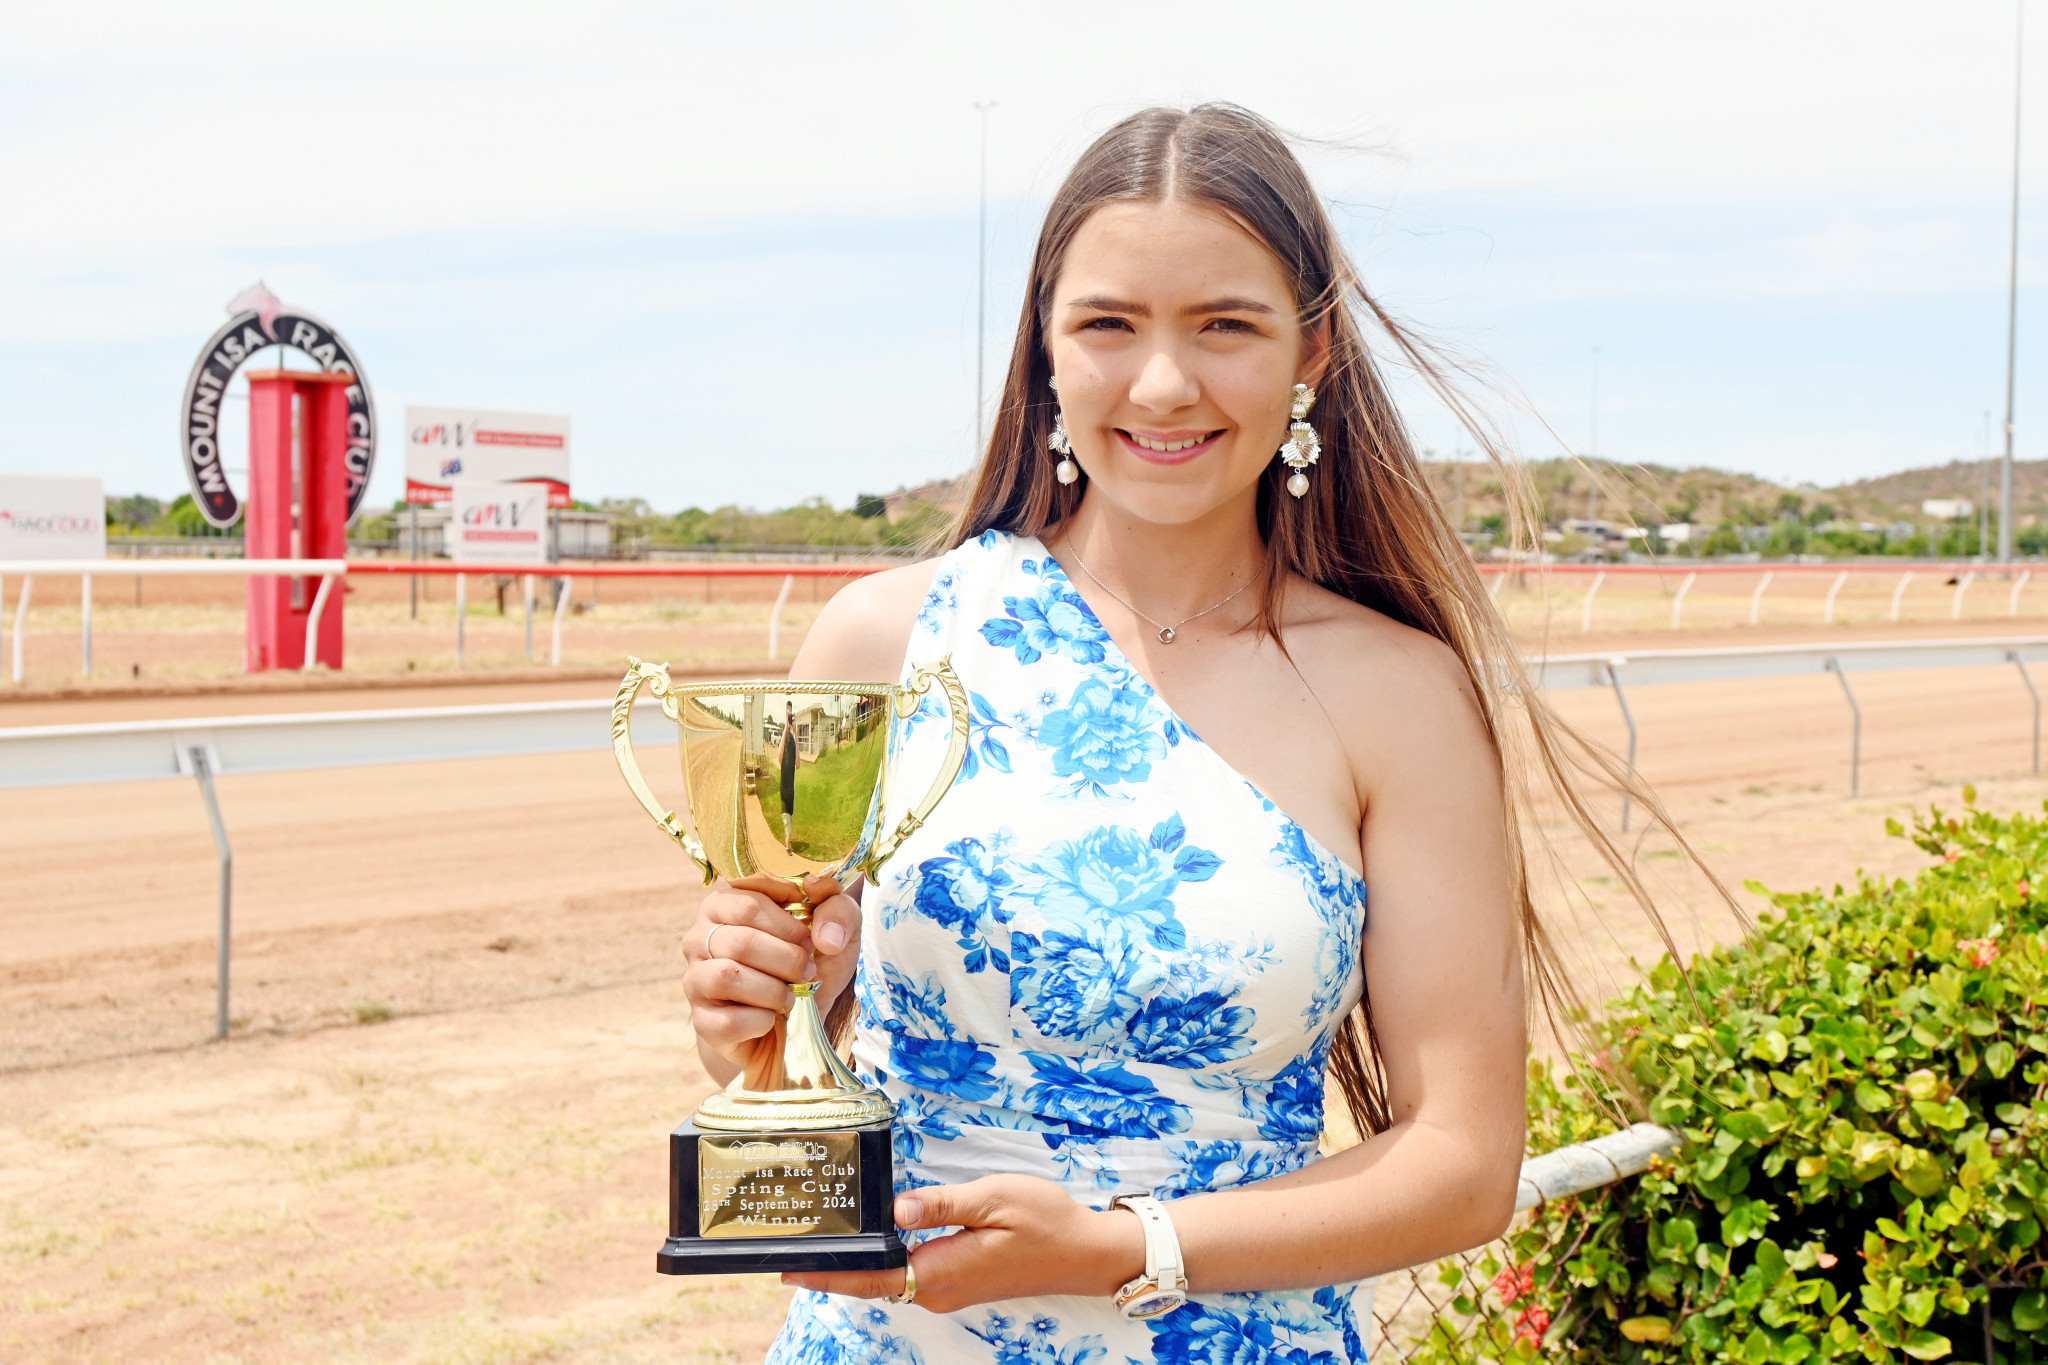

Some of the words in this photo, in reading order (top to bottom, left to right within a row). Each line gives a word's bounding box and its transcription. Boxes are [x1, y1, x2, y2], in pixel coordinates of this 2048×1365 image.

[190, 367, 227, 493] MOUNT
[213, 326, 266, 372] ISA
[702, 1167, 747, 1179] Mount
[755, 1166, 774, 1178] Isa
[783, 1165, 814, 1177] Race
[821, 1163, 855, 1176] Club
[711, 1182, 785, 1198] Spring
[801, 1180, 847, 1196] Cup
[739, 1197, 814, 1213] September
[822, 1196, 856, 1208] 2024
[737, 1214, 822, 1227] Winner
